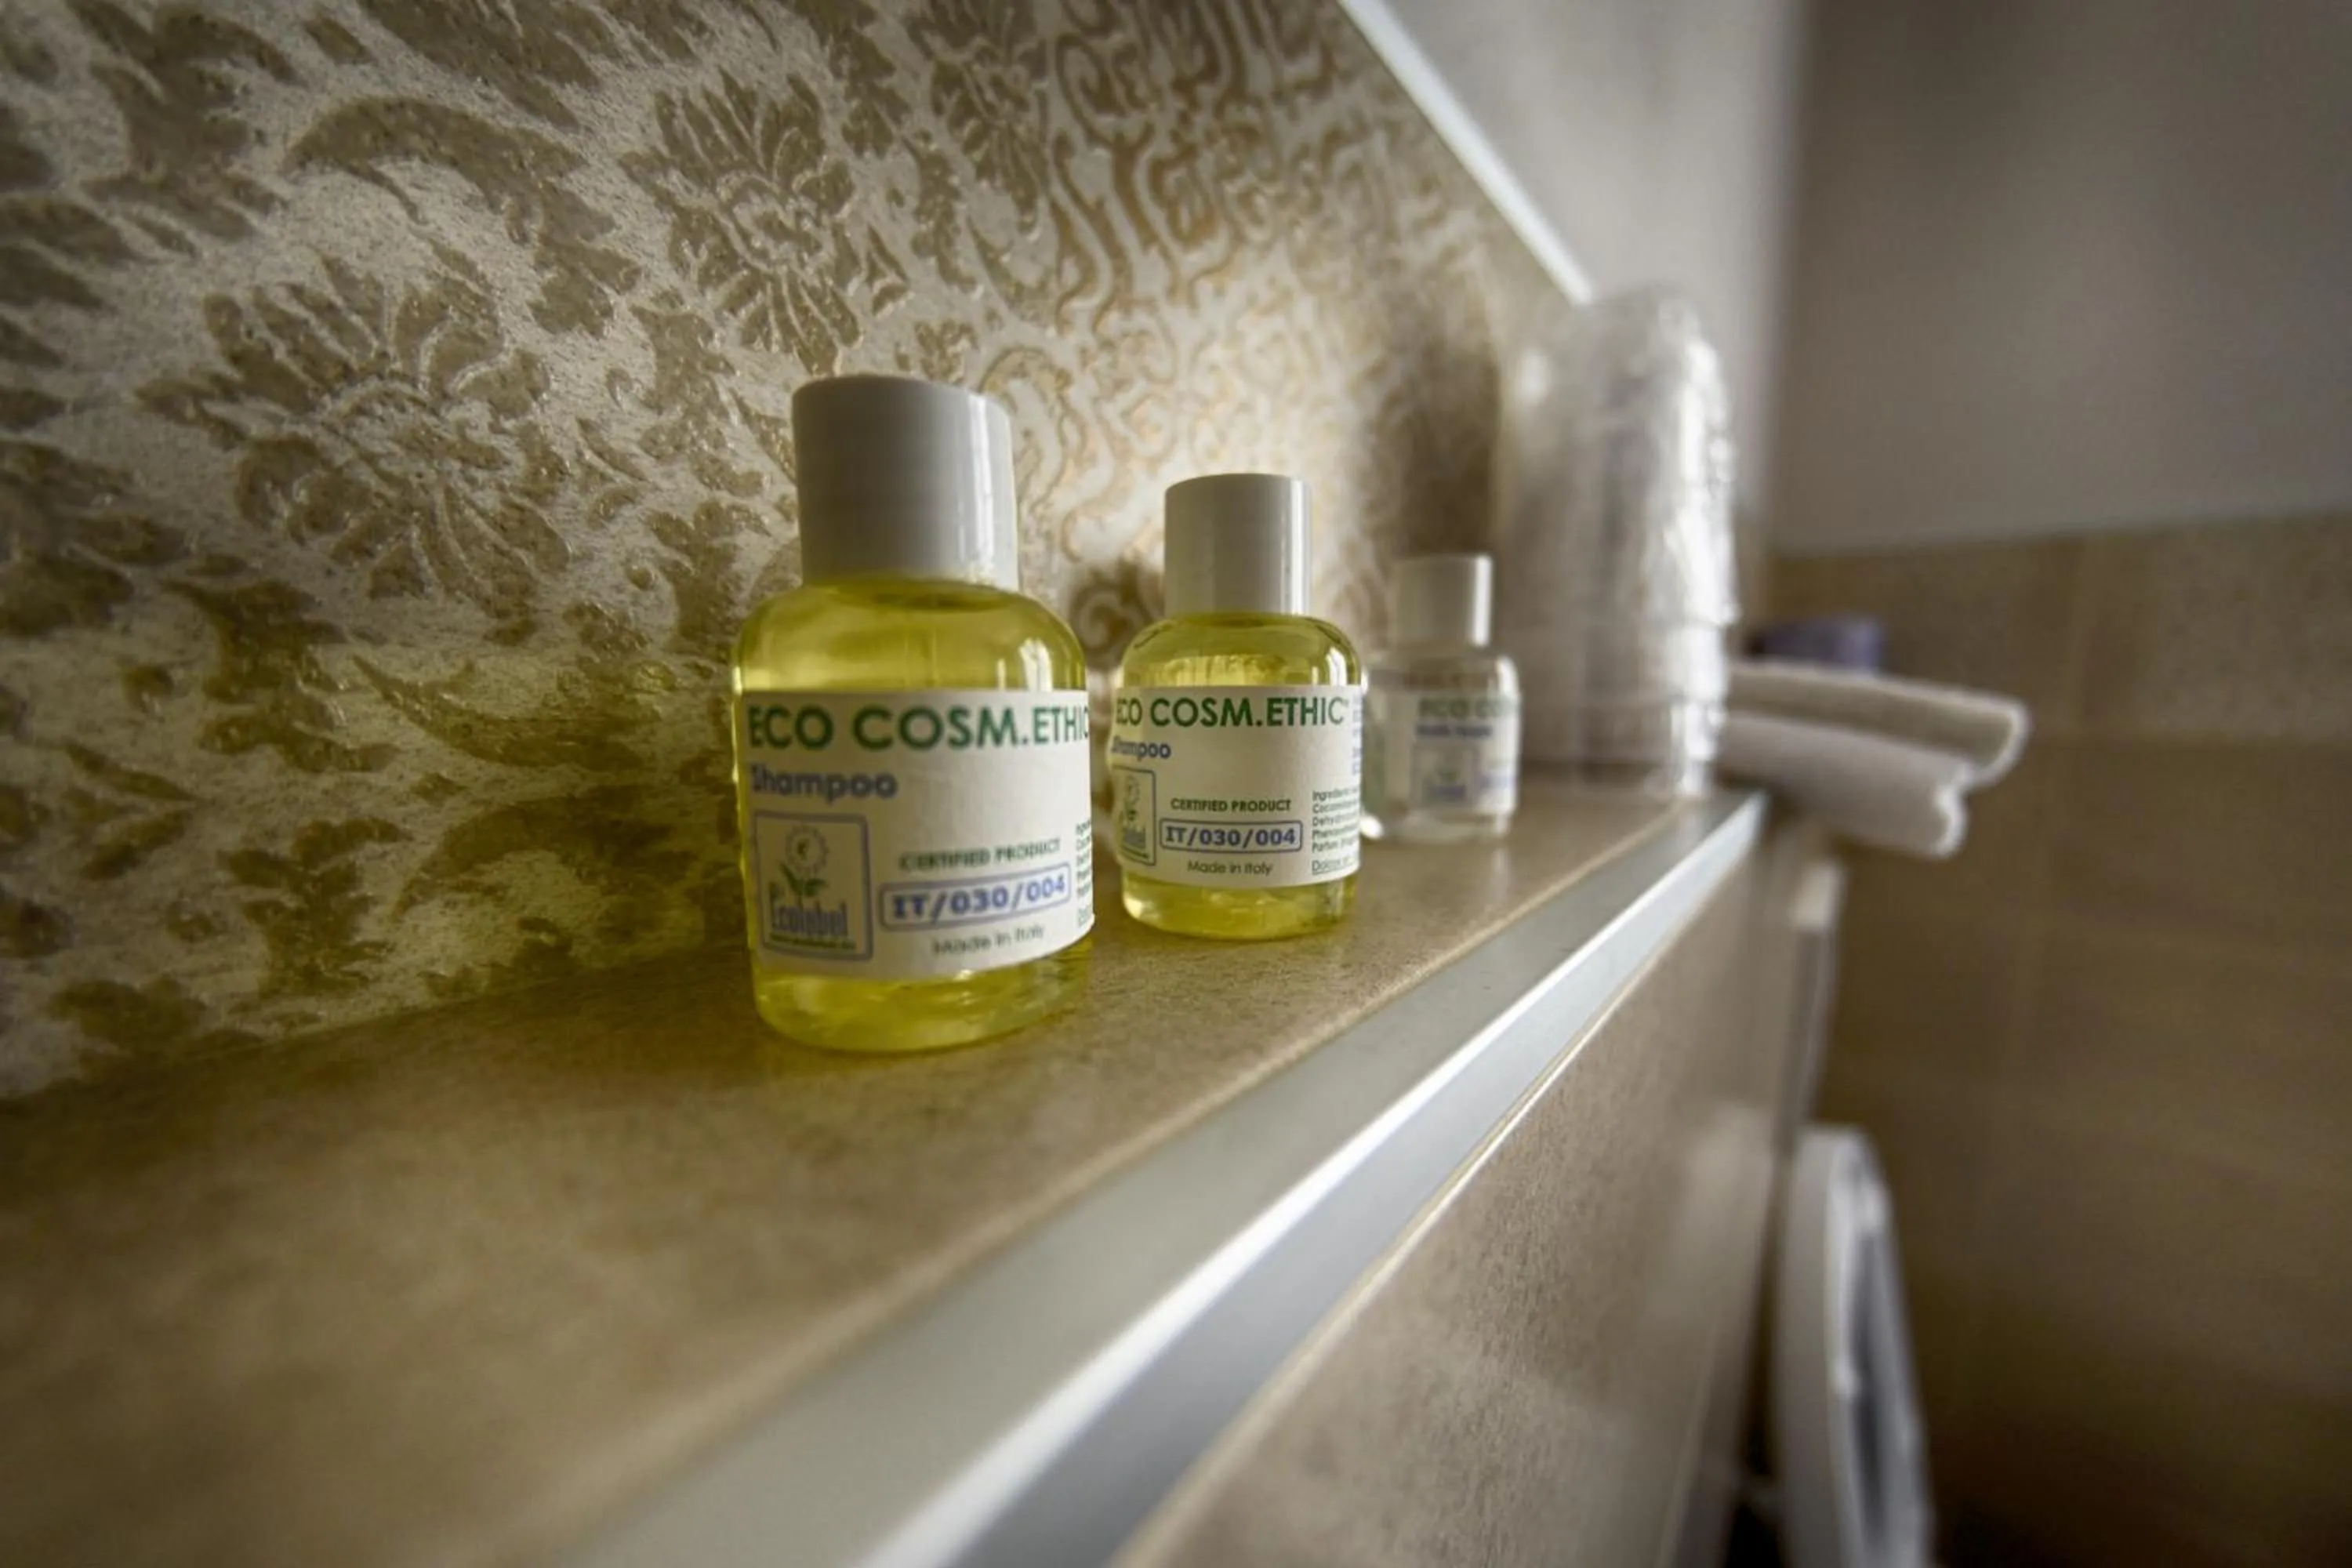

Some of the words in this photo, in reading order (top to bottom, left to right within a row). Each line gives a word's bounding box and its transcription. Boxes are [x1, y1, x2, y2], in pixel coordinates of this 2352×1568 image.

[748, 704, 834, 750] ECO
[1116, 697, 1142, 726] ECO
[1150, 697, 1346, 728] COSM.ETHIC
[1171, 798, 1229, 811] CERTIFIED
[1231, 799, 1292, 812] PRODUCT
[1165, 826, 1296, 849] IT/030/004
[898, 848, 991, 870] CERTIFIED
[994, 837, 1062, 862] PRODUCT
[1187, 860, 1226, 873] Made
[1229, 862, 1242, 874] in
[1243, 861, 1273, 875] Italy
[891, 874, 1065, 924] IT/030/004
